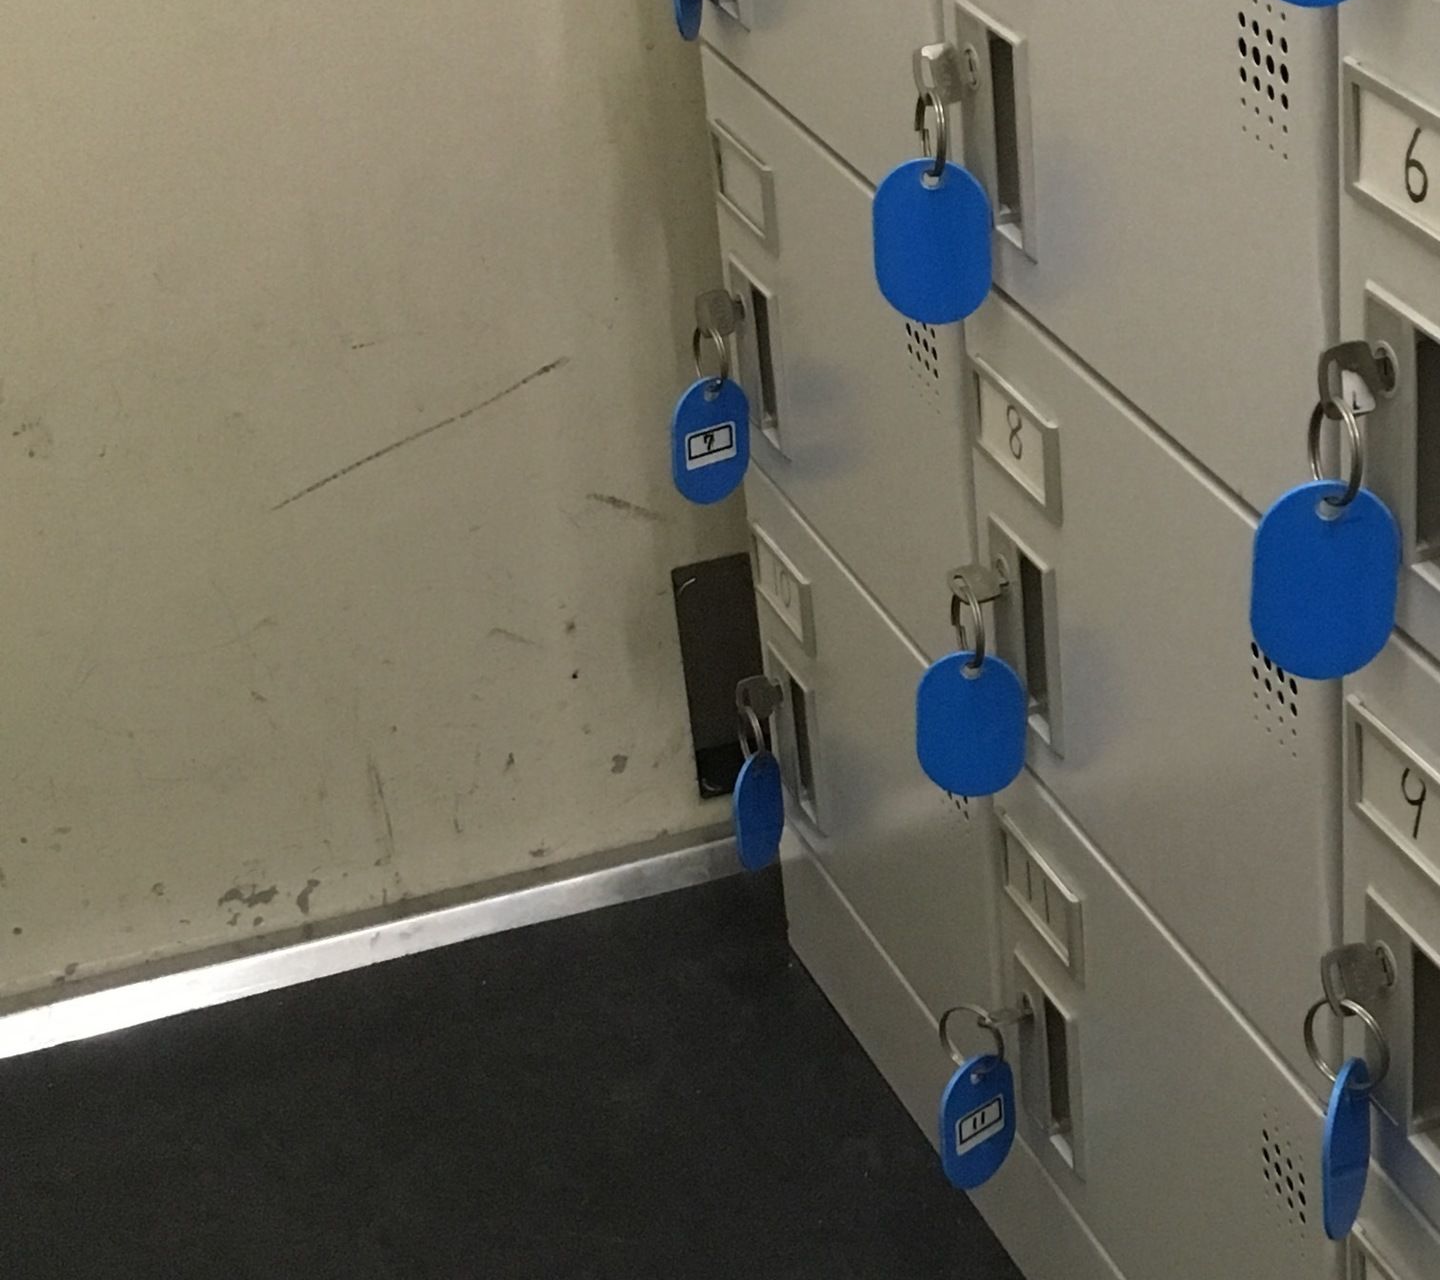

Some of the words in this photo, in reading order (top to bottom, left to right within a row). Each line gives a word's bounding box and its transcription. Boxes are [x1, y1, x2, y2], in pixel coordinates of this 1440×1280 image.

[1404, 127, 1428, 203] 6
[703, 433, 715, 451] 7
[1006, 405, 1023, 460] 8
[775, 566, 791, 608] 10
[1400, 767, 1427, 839] 9
[1025, 860, 1050, 923] 11
[972, 1115, 986, 1130] 11
